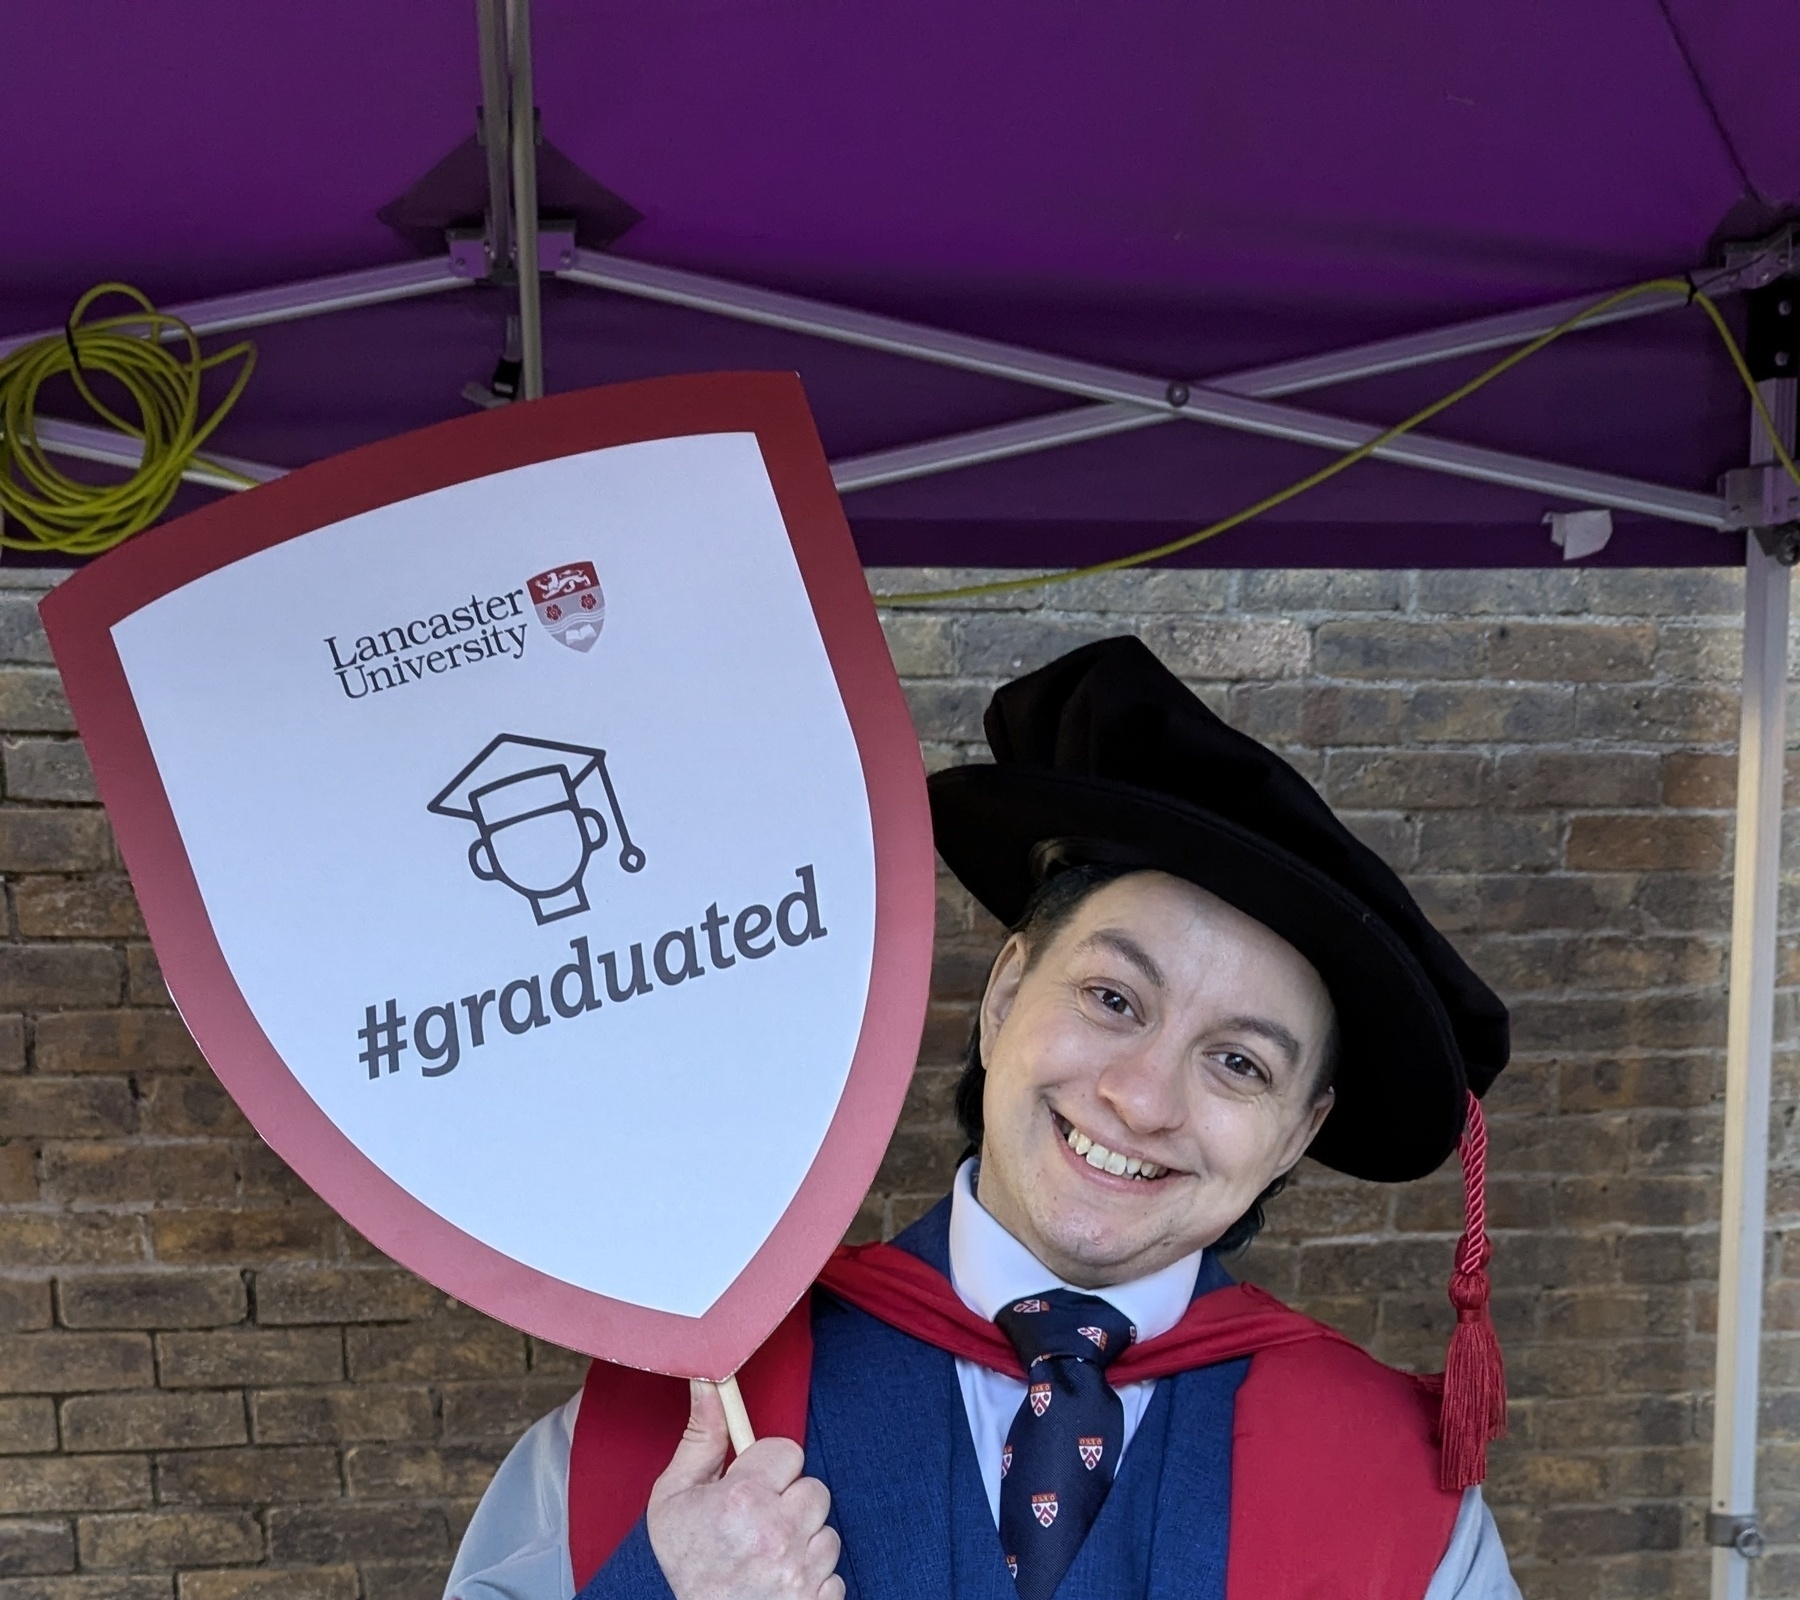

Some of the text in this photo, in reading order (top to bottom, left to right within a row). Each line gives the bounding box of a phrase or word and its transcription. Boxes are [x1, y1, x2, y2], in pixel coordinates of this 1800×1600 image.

[323, 589, 524, 671] Lancaster
[335, 623, 528, 699] University
[357, 864, 828, 1080] #graduated
